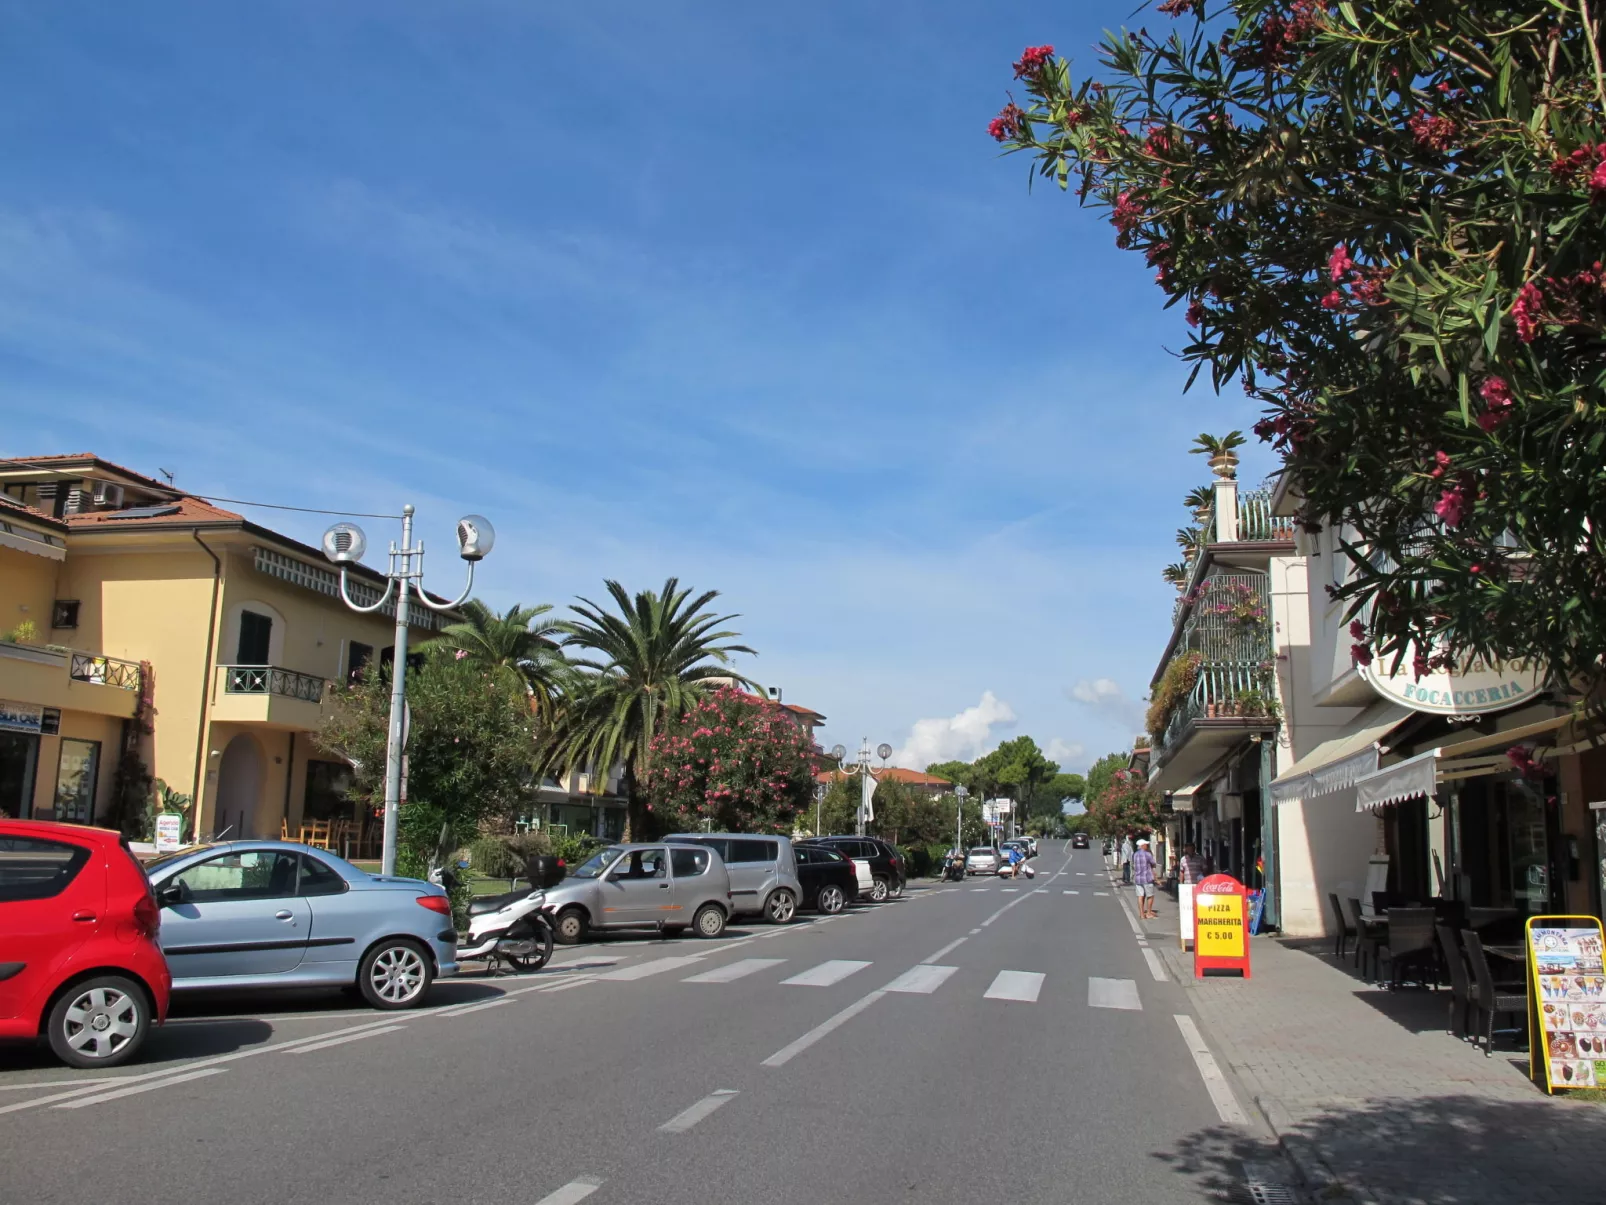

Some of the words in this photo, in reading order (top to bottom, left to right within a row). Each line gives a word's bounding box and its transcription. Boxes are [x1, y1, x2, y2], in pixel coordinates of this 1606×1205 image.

[1377, 658, 1408, 676] La
[1403, 680, 1524, 706] FOCACCERIA
[1208, 904, 1231, 912] PIZZA
[1197, 917, 1242, 926] MARGHERITA
[1207, 931, 1212, 940] €
[1215, 931, 1233, 940] 5.00
